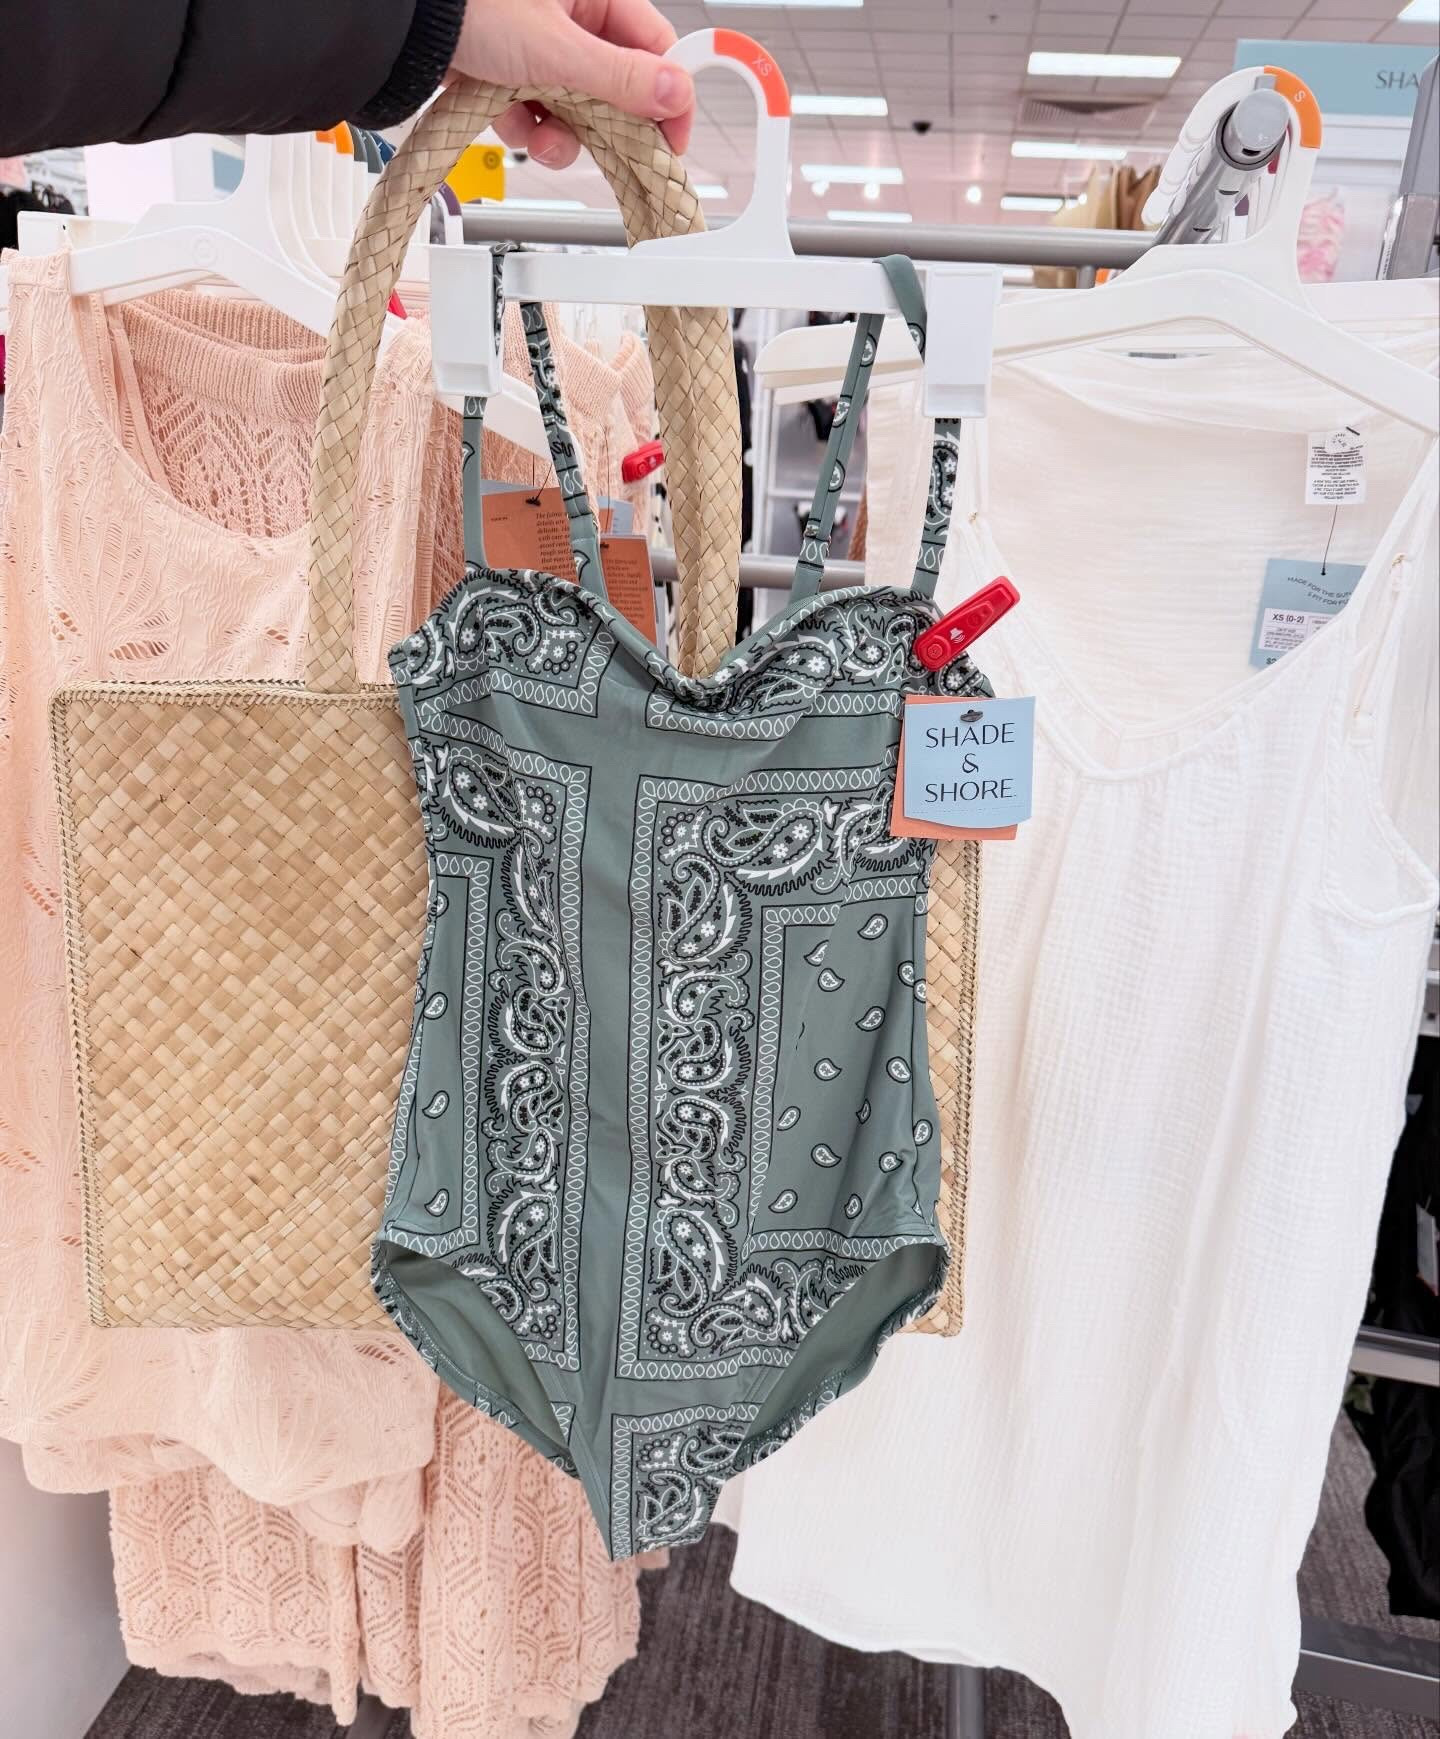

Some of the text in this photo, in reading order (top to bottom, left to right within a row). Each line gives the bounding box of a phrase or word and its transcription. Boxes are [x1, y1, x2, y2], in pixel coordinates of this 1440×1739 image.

[752, 53, 773, 77] XS
[1375, 69, 1421, 90] SHA
[1294, 90, 1305, 102] S
[1272, 613, 1285, 621] XS
[1286, 614, 1305, 624] (0-2)
[926, 722, 1015, 748] SHADE
[962, 752, 979, 774] &
